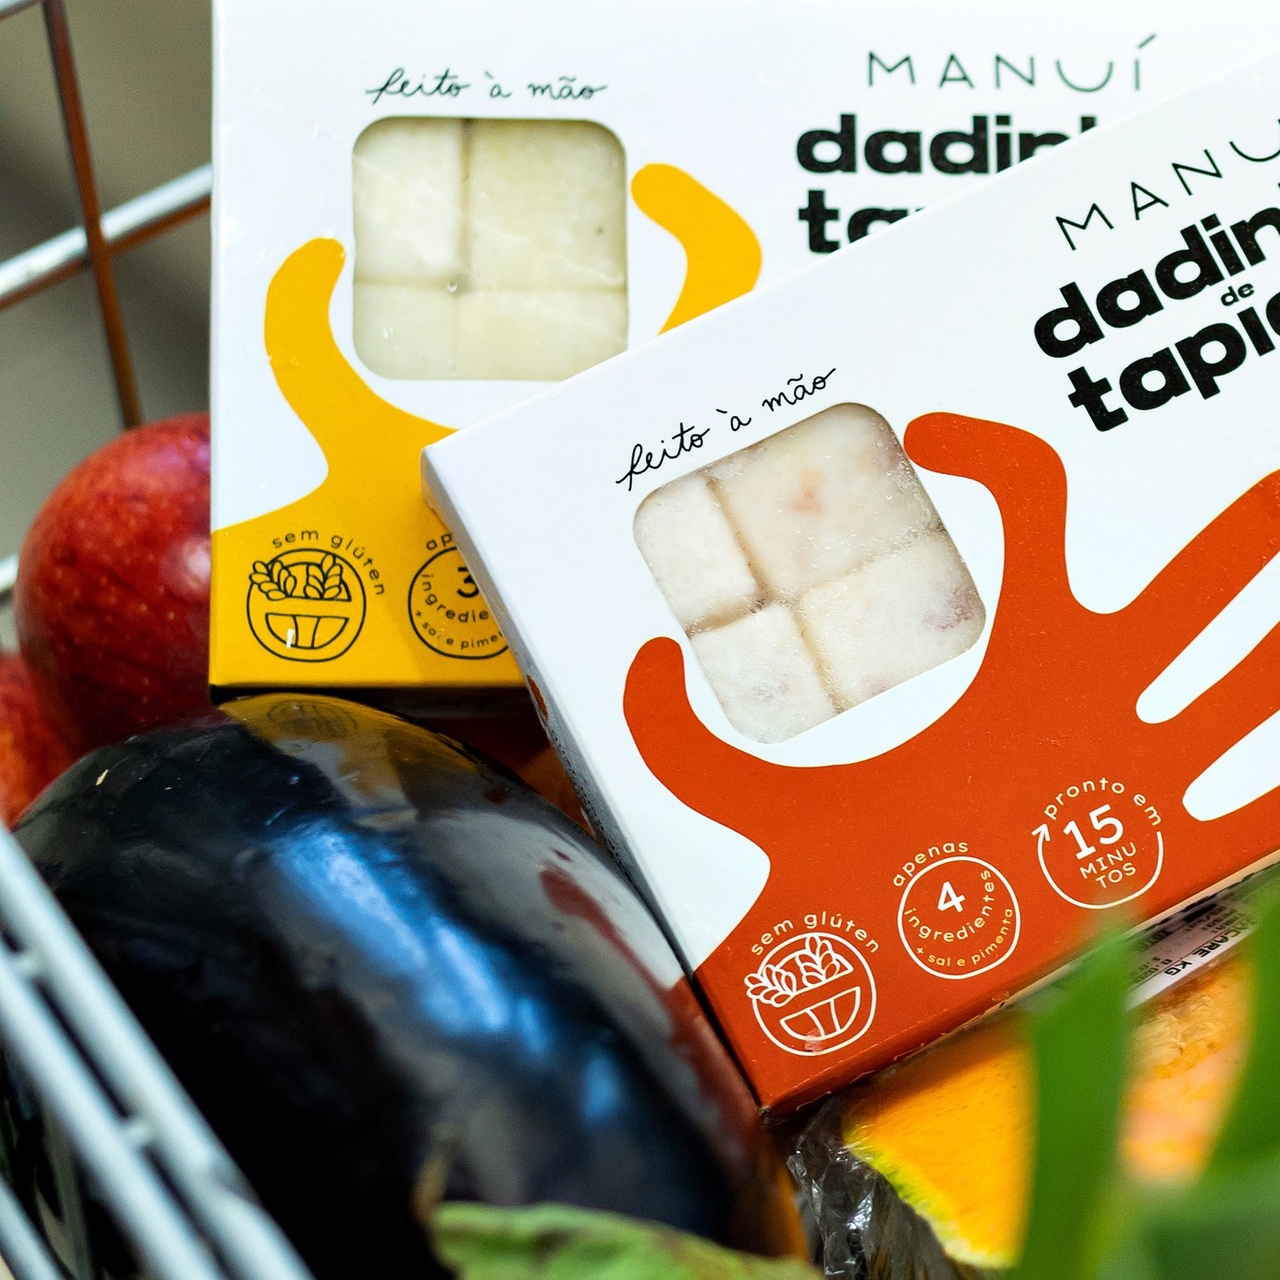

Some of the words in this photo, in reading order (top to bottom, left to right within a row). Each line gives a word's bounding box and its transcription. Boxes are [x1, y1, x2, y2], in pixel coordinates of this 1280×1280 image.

[364, 67, 472, 105] feito
[484, 70, 513, 99] à
[528, 76, 609, 100] mão
[868, 33, 1157, 92] MANUÍ
[796, 114, 1098, 174] dadin
[1220, 282, 1256, 307] de
[615, 422, 711, 492] feito
[715, 408, 752, 432] à
[761, 367, 837, 412] mão
[272, 530, 319, 549] sem
[330, 534, 386, 596] glúten
[1043, 777, 1125, 821] pronto
[1133, 793, 1162, 827] em
[1062, 803, 1125, 861] 15
[892, 841, 969, 887] apenas
[1079, 841, 1137, 880] MINU
[1095, 862, 1137, 889] TOS
[903, 869, 995, 942] ingredientes
[937, 881, 966, 913] 4
[751, 919, 794, 956] sem
[803, 910, 880, 953] glúten
[927, 953, 951, 967] sal
[956, 957, 966, 967] e
[971, 907, 1013, 965] pimenta
[1164, 960, 1193, 976] KG
